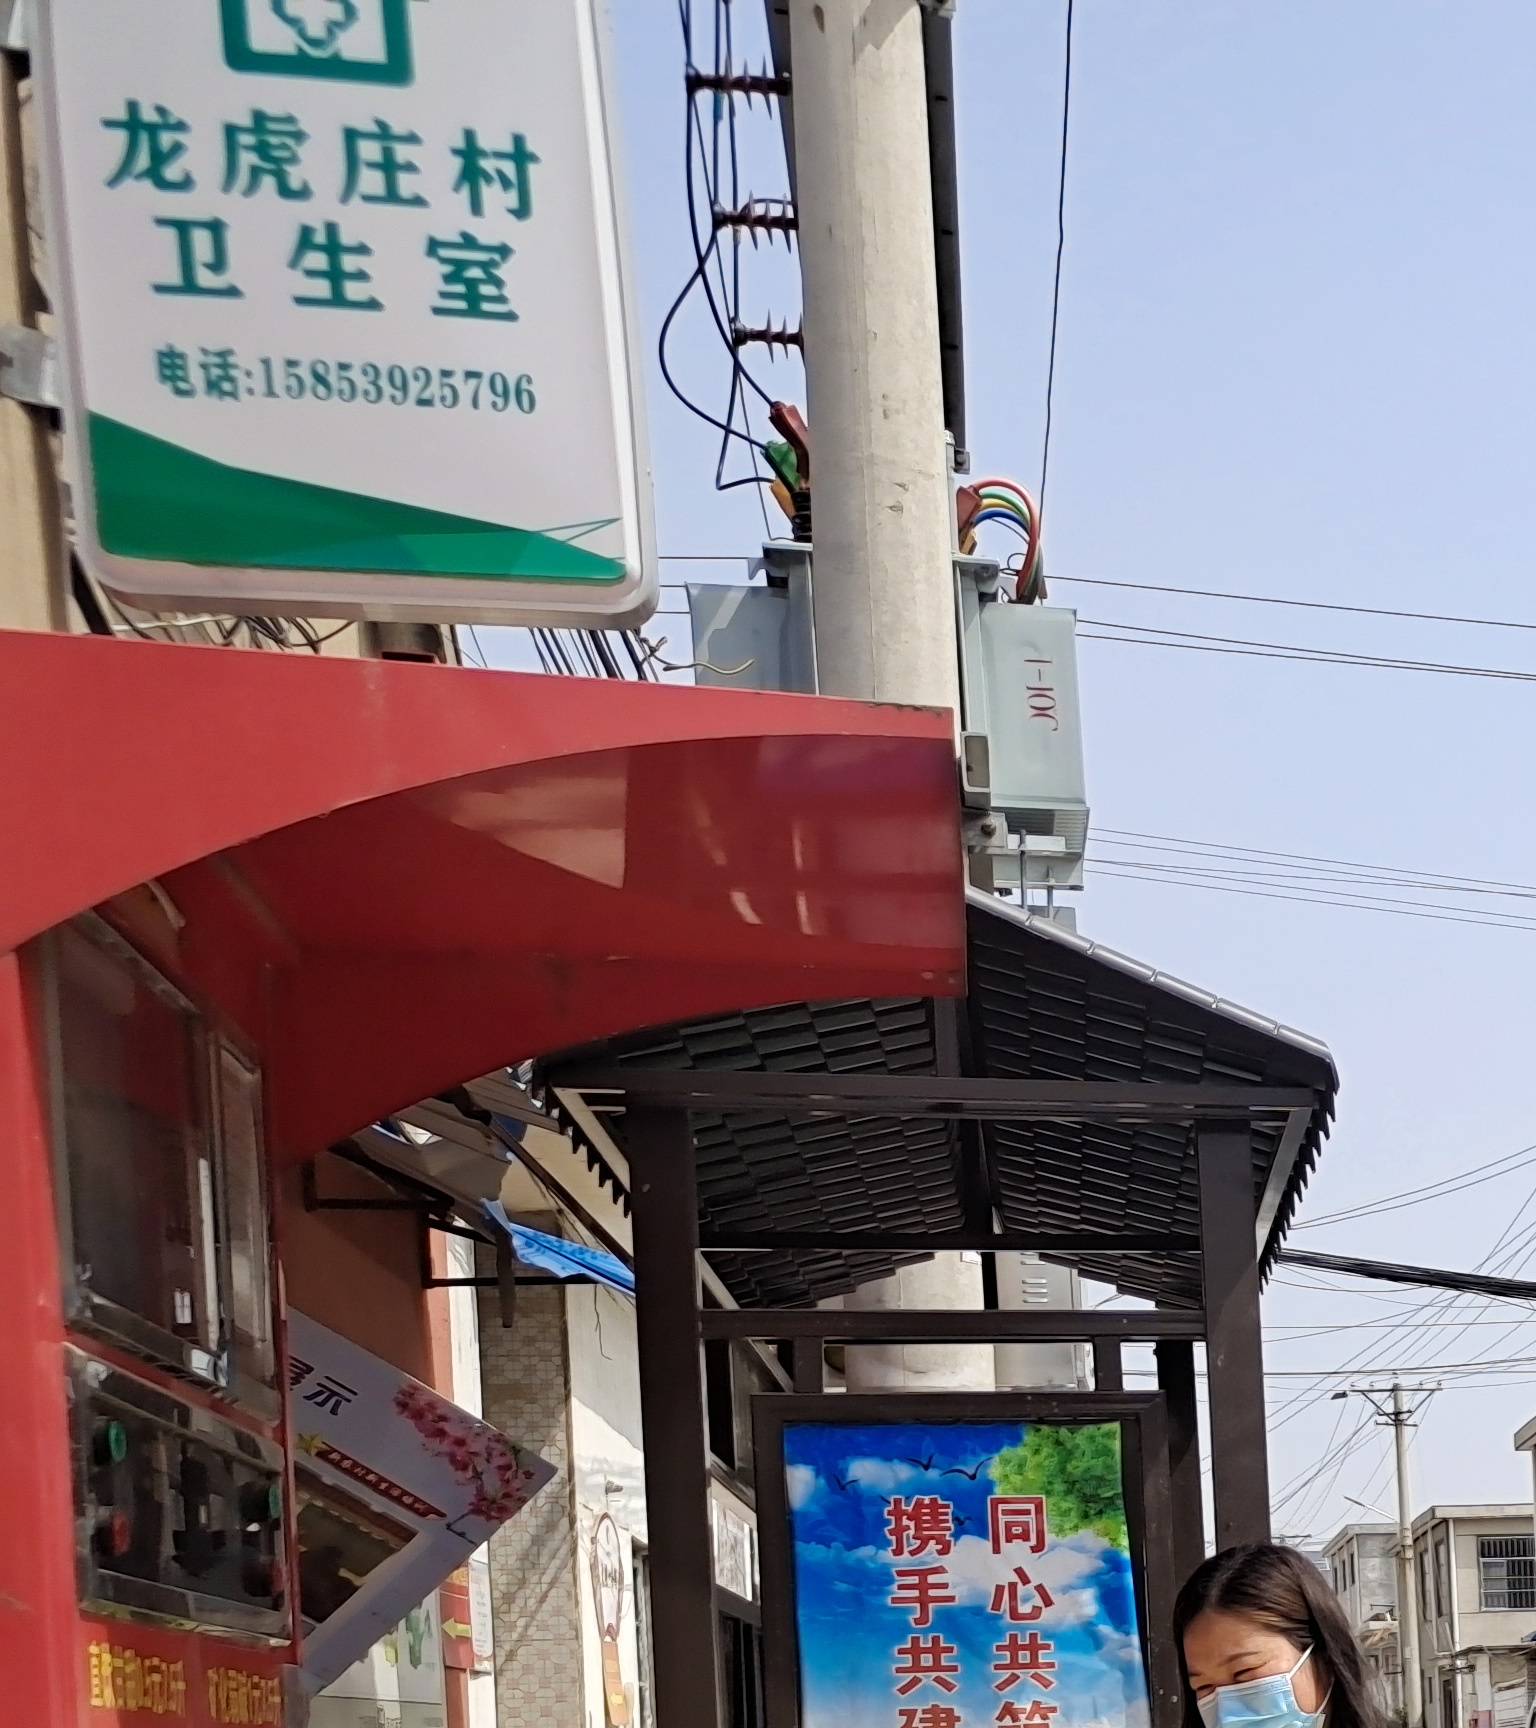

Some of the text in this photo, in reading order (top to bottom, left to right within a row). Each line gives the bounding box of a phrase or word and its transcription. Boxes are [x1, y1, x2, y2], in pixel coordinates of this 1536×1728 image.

[100, 98, 541, 221] 龙虎庄村
[152, 214, 521, 324] 卫生室
[155, 344, 538, 415] 电话:15853925796
